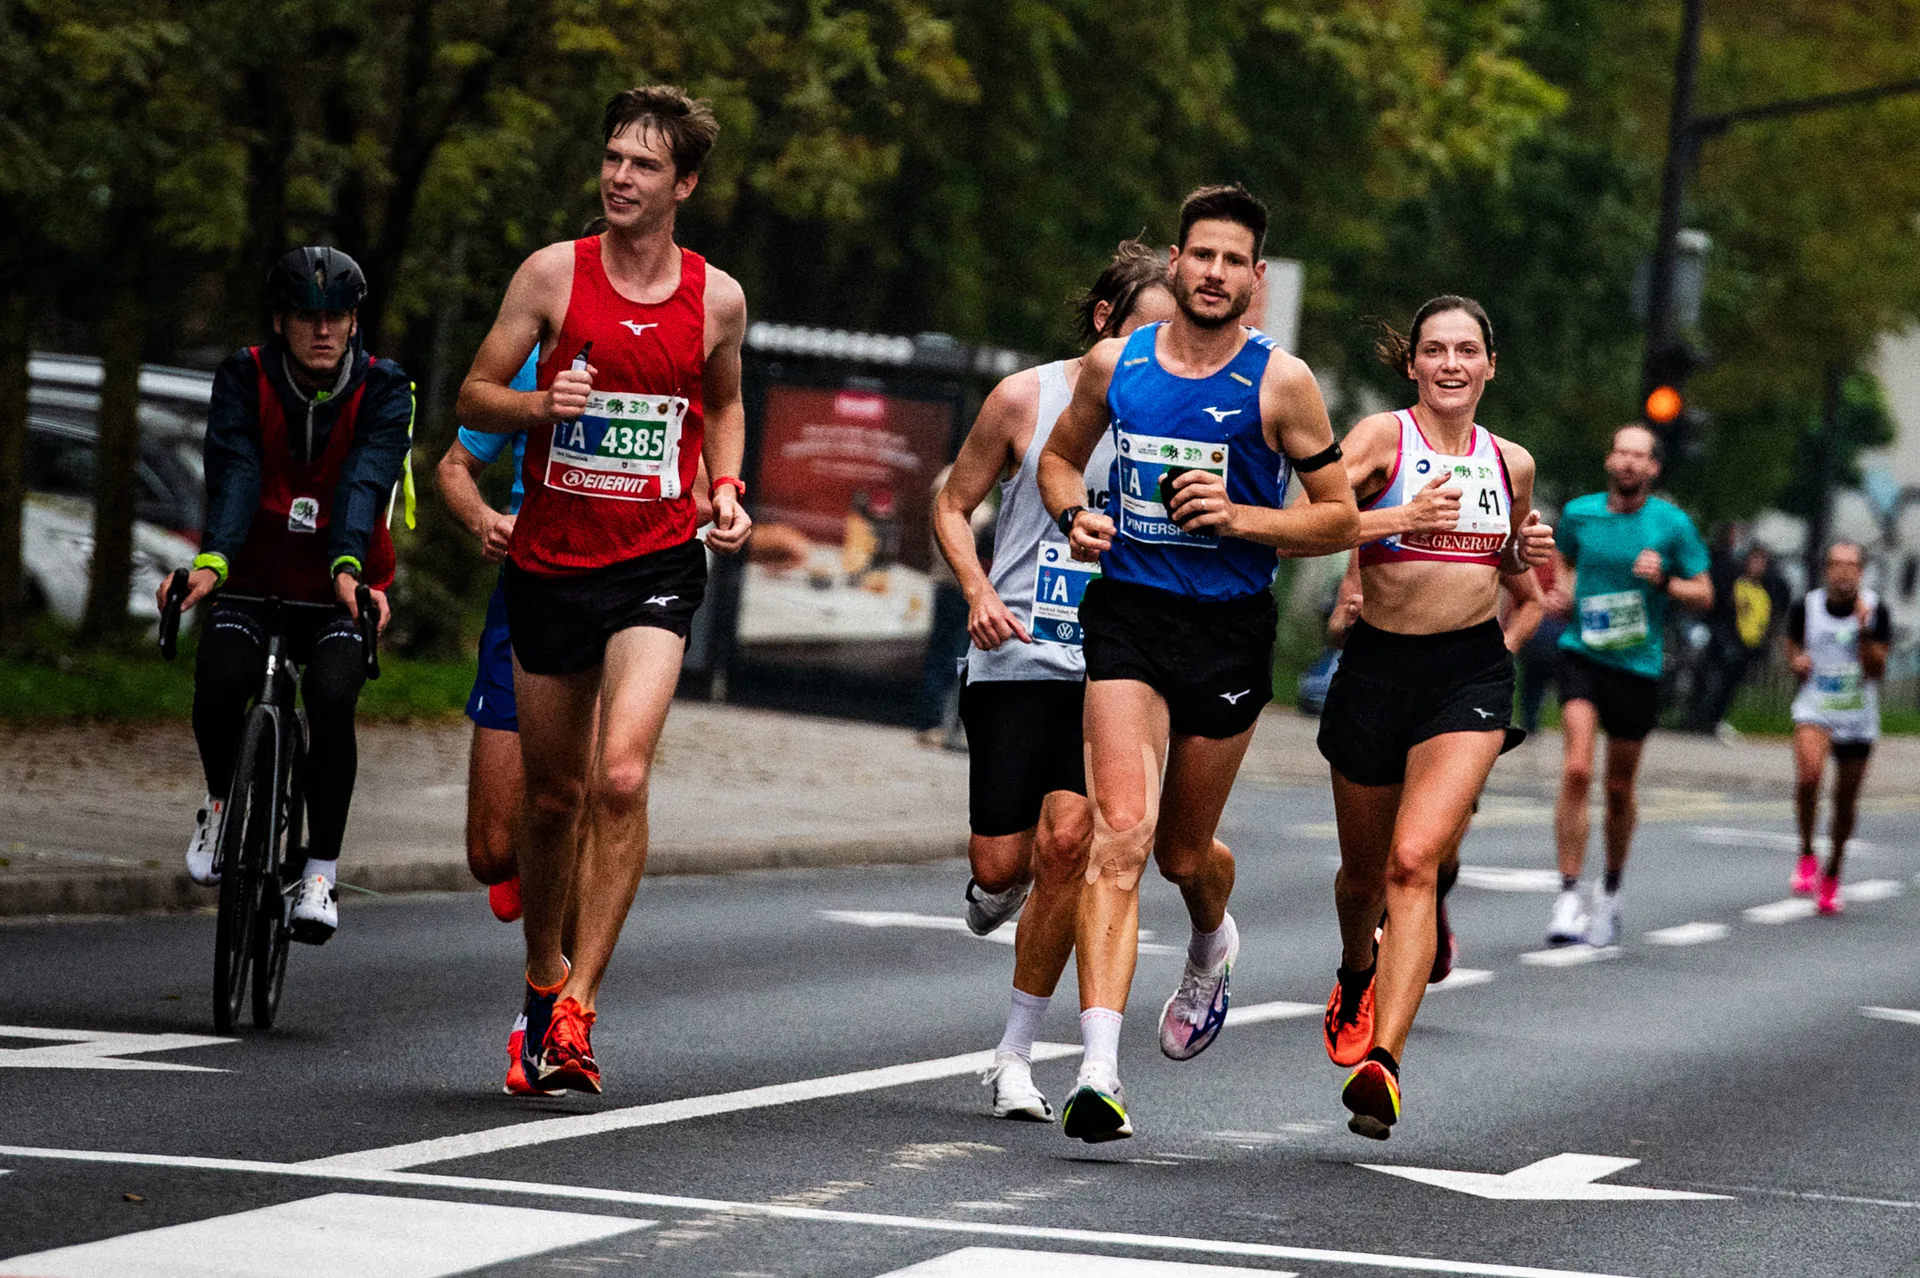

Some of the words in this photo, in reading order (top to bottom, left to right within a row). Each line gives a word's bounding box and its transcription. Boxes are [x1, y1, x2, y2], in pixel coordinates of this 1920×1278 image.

[569, 421, 586, 450] A
[601, 426, 664, 457] 4385
[583, 473, 648, 493] ENERVIT
[1129, 467, 1142, 497] A
[1478, 488, 1501, 516] 41
[1432, 534, 1499, 551] GENERALI
[1050, 575, 1069, 603] A
